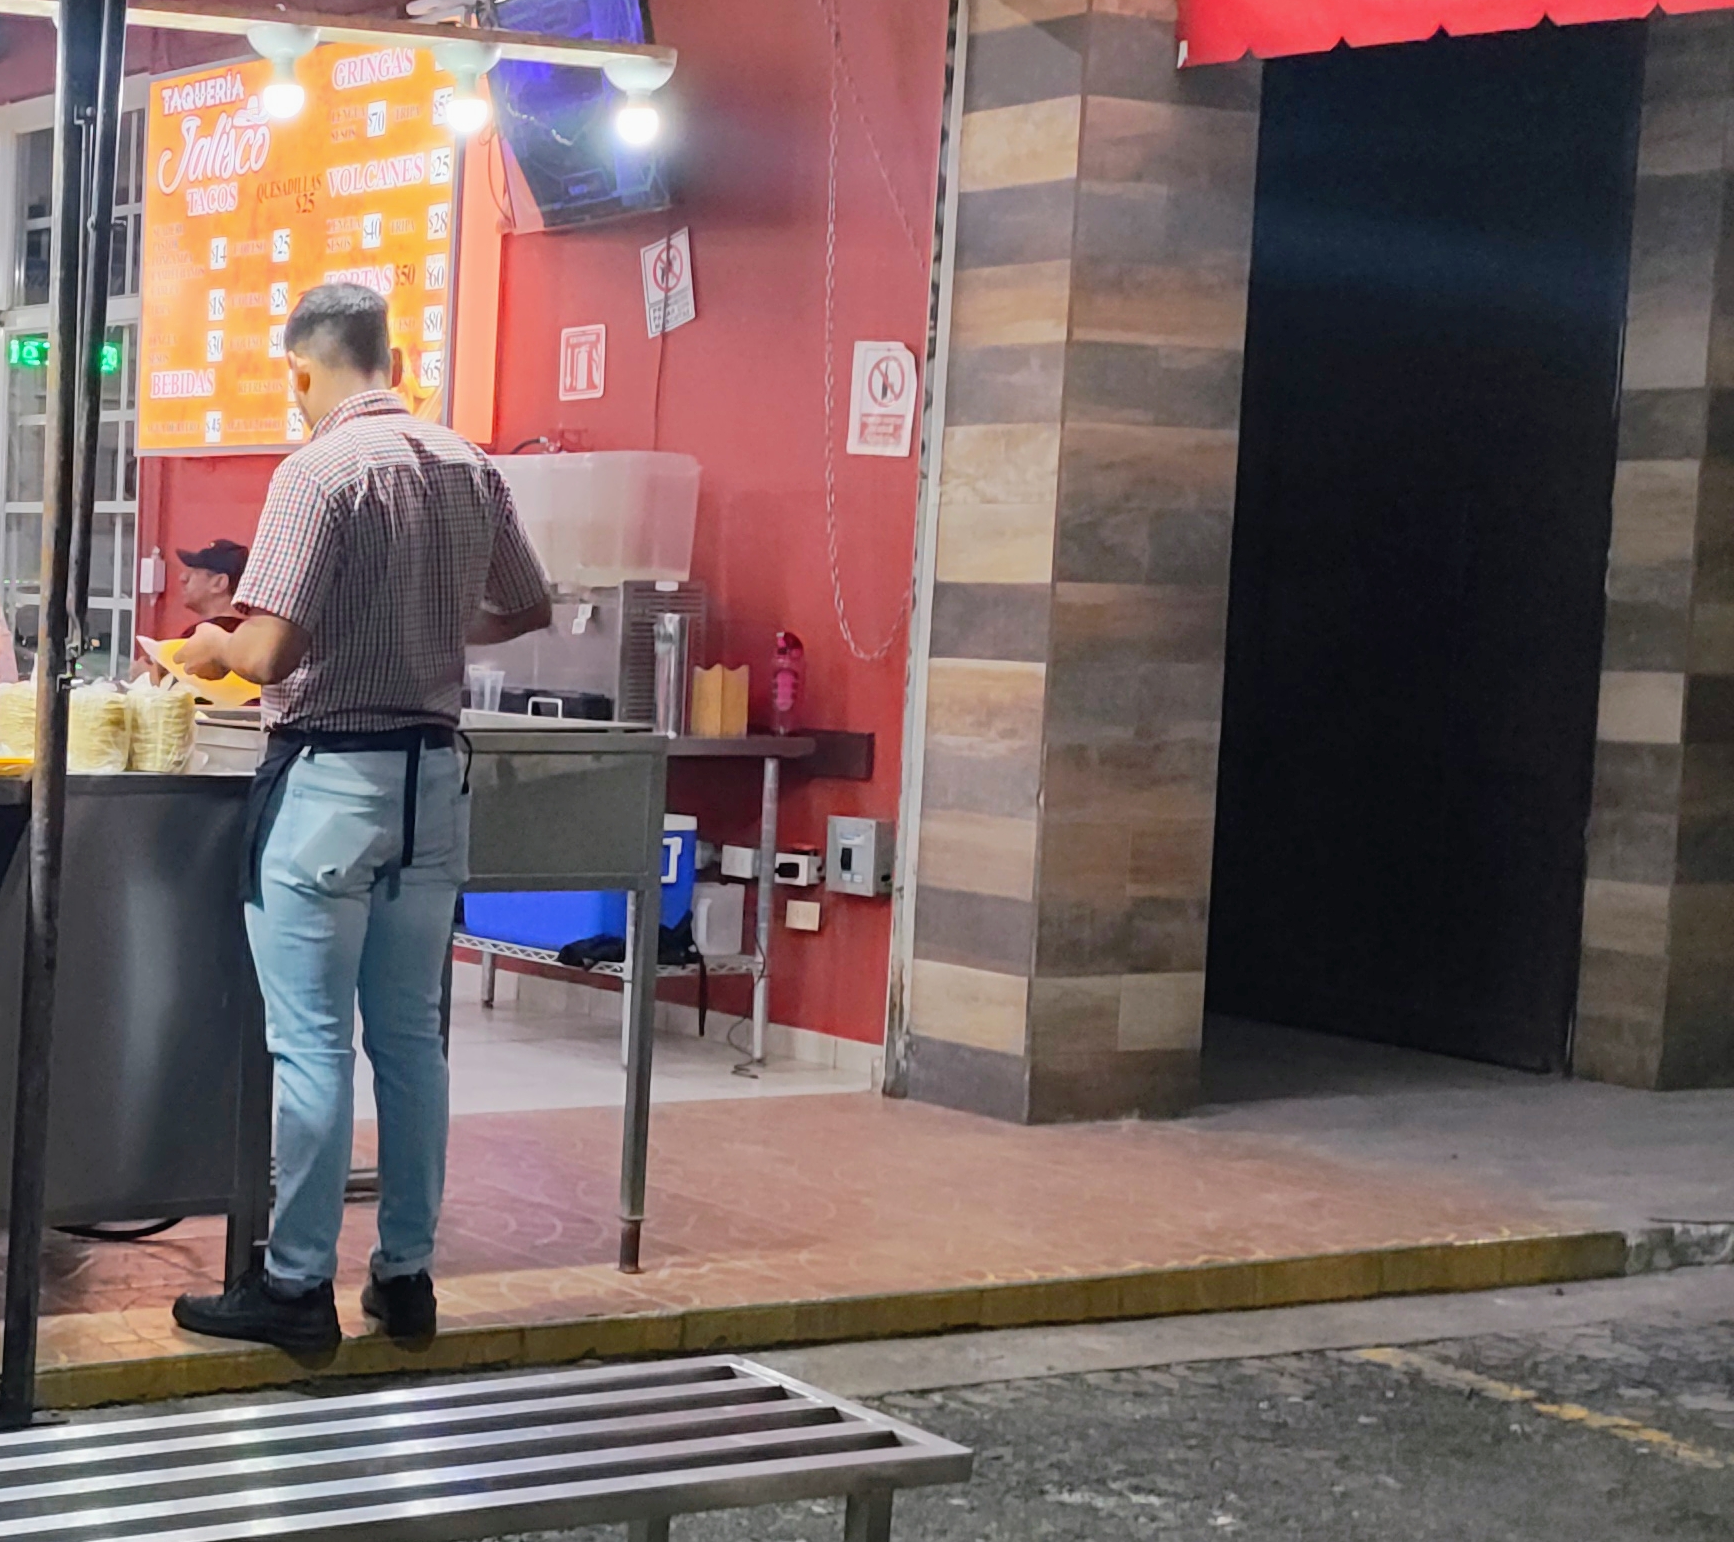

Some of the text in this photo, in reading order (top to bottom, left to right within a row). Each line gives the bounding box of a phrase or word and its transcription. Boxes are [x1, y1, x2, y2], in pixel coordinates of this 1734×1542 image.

[333, 47, 415, 88] GRINGAS
[158, 112, 271, 195] Jalisco
[187, 174, 322, 216] TACOS QUESADILLAS
[327, 153, 425, 197] VOLCANES
[295, 192, 316, 214] $25
[151, 369, 215, 397] BEBIDAS
